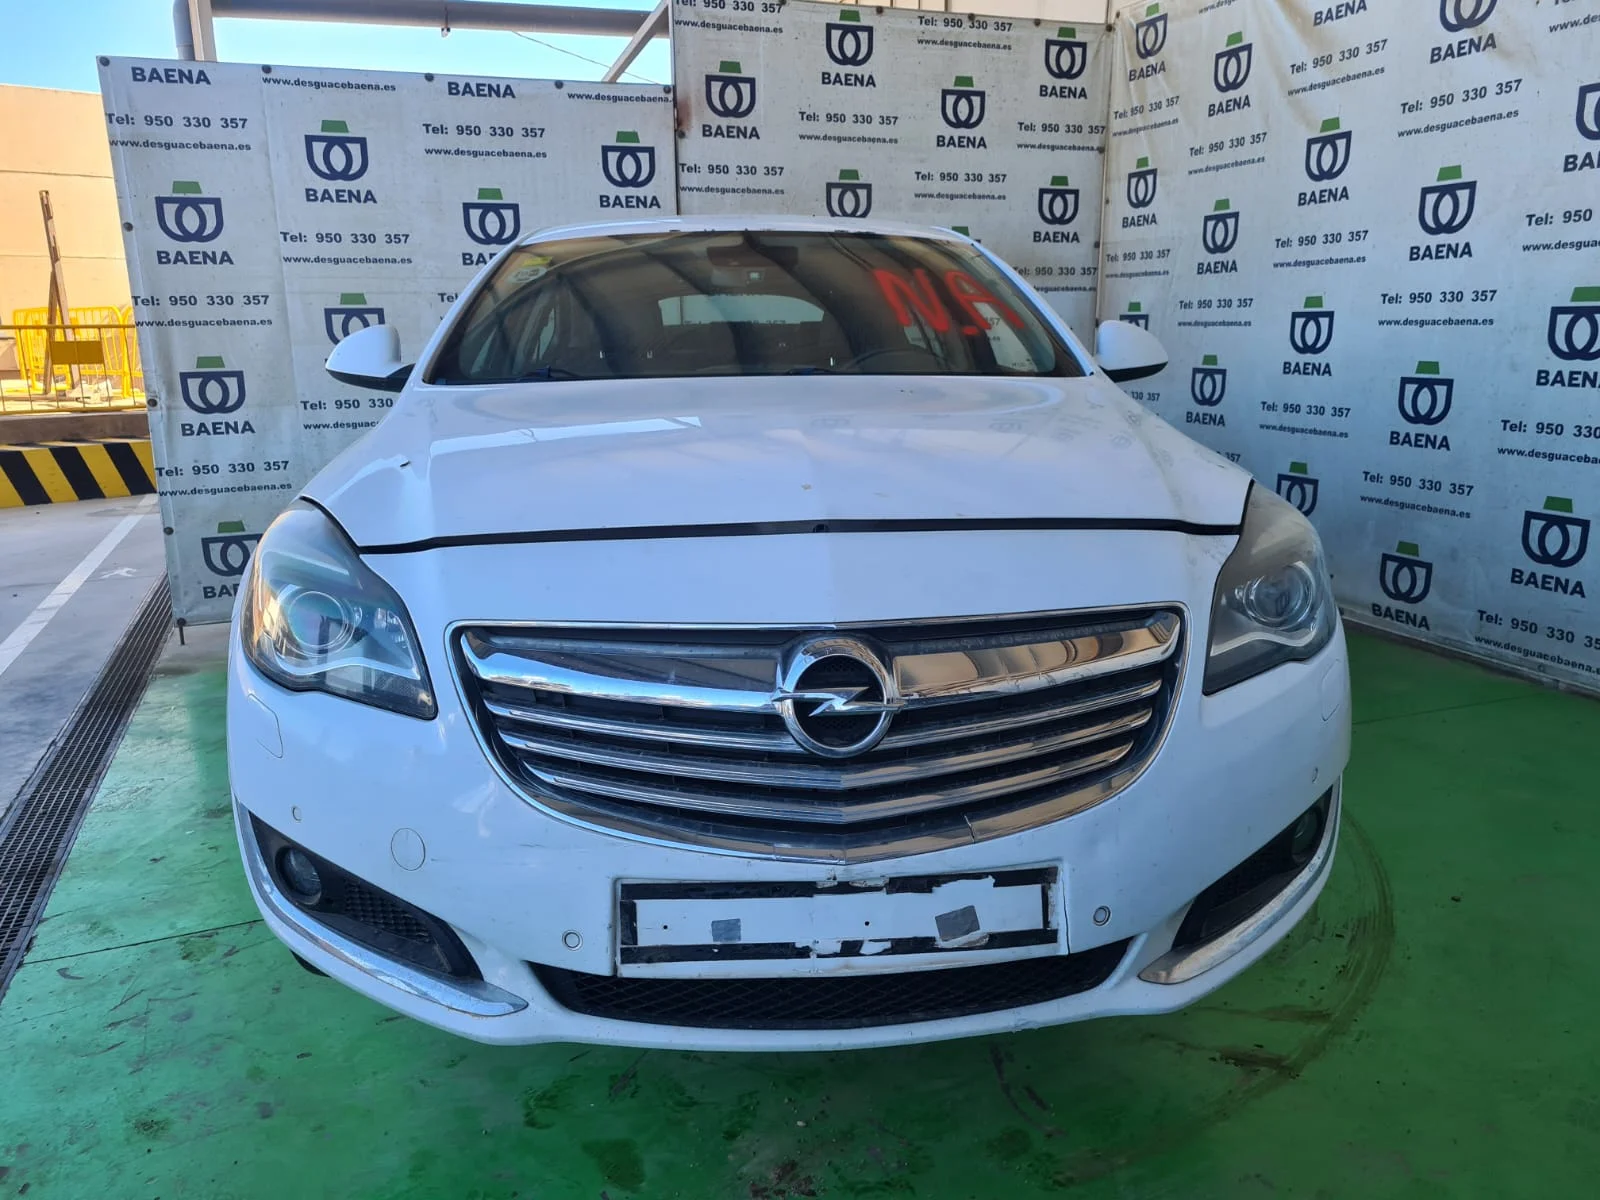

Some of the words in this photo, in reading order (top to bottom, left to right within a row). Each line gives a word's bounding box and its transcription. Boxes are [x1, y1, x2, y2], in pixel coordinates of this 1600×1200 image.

[704, 0, 725, 9] 950
[733, 1, 754, 11] 330
[762, 3, 783, 13] 357
[1313, 0, 1367, 26] BAENA
[675, 19, 783, 34] www.desguacebaena.es
[918, 16, 937, 26] Tel:
[944, 18, 963, 28] 950
[968, 20, 988, 29] 330
[994, 22, 1012, 31] 357
[917, 38, 1011, 50] www.desguacebaena.es
[1430, 33, 1496, 64] BAENA
[1290, 62, 1306, 74] Tel:
[1313, 54, 1332, 68] 950
[1339, 47, 1359, 61] 330
[1366, 39, 1387, 54] 357
[131, 67, 211, 85] BAENA
[1129, 61, 1165, 81] BAENA
[262, 78, 396, 91] www.desguacebaena.es
[822, 72, 876, 87] BAENA
[1288, 66, 1384, 96] www.desguacebaena.es
[448, 82, 516, 98] BAENA
[1040, 85, 1087, 99] BAENA
[1401, 100, 1422, 114] Tel:
[1431, 93, 1454, 108] 950
[1462, 86, 1487, 102] 330
[1496, 79, 1522, 95] 357
[1114, 110, 1128, 119] Tel:
[1149, 101, 1162, 112] 330
[1166, 96, 1179, 107] 357
[1208, 95, 1250, 117] BAENA
[106, 113, 135, 125] Tel:
[144, 115, 173, 126] 950
[183, 117, 211, 128] 330
[220, 118, 247, 128] 357
[799, 112, 819, 121] Tel:
[826, 113, 845, 123] 950
[853, 114, 872, 124] 330
[879, 116, 898, 125] 357
[1398, 109, 1518, 137] www.desguacebaena.es
[423, 124, 448, 134] Tel:
[456, 125, 481, 136] 950
[490, 127, 513, 136] 330
[522, 128, 544, 137] 357
[702, 124, 760, 139] BAENA
[1018, 122, 1035, 131] Tel:
[1042, 123, 1059, 132] 950
[1065, 124, 1082, 133] 330
[1088, 126, 1106, 134] 357
[110, 140, 251, 150] www.desguacebaena.es
[799, 134, 898, 144] www.desguacebaena.es
[937, 135, 987, 148] BAENA
[1190, 146, 1204, 156] Tel:
[1209, 141, 1224, 152] 950
[1229, 137, 1245, 148] 330
[1250, 132, 1267, 144] 357
[425, 148, 546, 158] www.desguacebaena.es
[679, 163, 701, 174] Tel:
[708, 165, 729, 174] 950
[736, 165, 757, 175] 330
[764, 167, 784, 176] 357
[1188, 157, 1265, 175] www.desguacebaena.es
[915, 172, 933, 180] Tel:
[940, 173, 958, 181] 950
[965, 173, 982, 182] 330
[989, 174, 1006, 182] 357
[305, 188, 377, 203] BAENA
[680, 184, 784, 196] www.desguacebaena.es
[915, 192, 1006, 200] www.desguacebaena.es
[1298, 186, 1349, 206] BAENA
[600, 195, 661, 208] BAENA
[1122, 214, 1157, 228] BAENA
[1526, 213, 1553, 226] Tel:
[1563, 209, 1592, 223] 950
[280, 232, 307, 242] Tel:
[316, 233, 342, 243] 950
[351, 234, 376, 243] 330
[385, 234, 409, 244] 357
[1033, 231, 1080, 243] BAENA
[1275, 238, 1292, 248] Tel:
[1298, 235, 1316, 246] 950
[1323, 233, 1341, 244] 330
[1348, 230, 1368, 242] 357
[157, 251, 233, 264] BAENA
[1409, 242, 1472, 261] BAENA
[283, 256, 412, 265] www.desguacebaena.es
[1197, 260, 1237, 274] BAENA
[1273, 256, 1366, 268] www.desguacebaena.es
[132, 296, 160, 306] Tel:
[169, 296, 197, 305] 950
[207, 296, 233, 305] 330
[243, 295, 269, 305] 357
[1180, 301, 1193, 309] Tel:
[1198, 300, 1212, 309] 950
[1217, 299, 1232, 308] 330
[1237, 298, 1253, 307] 357
[1381, 293, 1402, 304] Tel:
[1410, 292, 1432, 303] 950
[1440, 291, 1463, 302] 330
[1472, 290, 1497, 302] 357
[135, 318, 272, 328] www.desguacebaena.es
[1378, 317, 1493, 328] www.desguacebaena.es
[1283, 362, 1331, 376] BAENA
[1536, 370, 1600, 388] BAEN
[301, 401, 326, 410] Tel:
[335, 400, 360, 409] 950
[369, 398, 393, 408] 330
[1261, 402, 1277, 411] Tel:
[1283, 403, 1301, 413] 950
[1306, 405, 1325, 416] 330
[1331, 407, 1350, 417] 357
[1186, 412, 1225, 426] BAENA
[181, 421, 255, 436] BAENA
[1260, 424, 1348, 438] www.desguacebaena.es
[1501, 420, 1526, 432] Tel:
[1536, 422, 1563, 435] 950
[1573, 425, 1600, 439] 330
[1390, 431, 1450, 451] BAENA
[155, 467, 183, 477] Tel:
[192, 465, 219, 475] 950
[229, 463, 254, 473] 330
[264, 461, 289, 471] 357
[159, 484, 292, 496] www.desguacebaena.es
[1363, 471, 1383, 483] Tel:
[1390, 475, 1411, 487] 950
[1419, 479, 1441, 491] 330
[1449, 483, 1473, 496] 357
[1360, 496, 1470, 518] www.desguacebaena.es
[1511, 568, 1585, 598] BAENA
[1371, 603, 1430, 630] BAENA
[1478, 610, 1502, 625] Tel:
[1511, 618, 1537, 633] 950
[1547, 627, 1574, 643] 330
